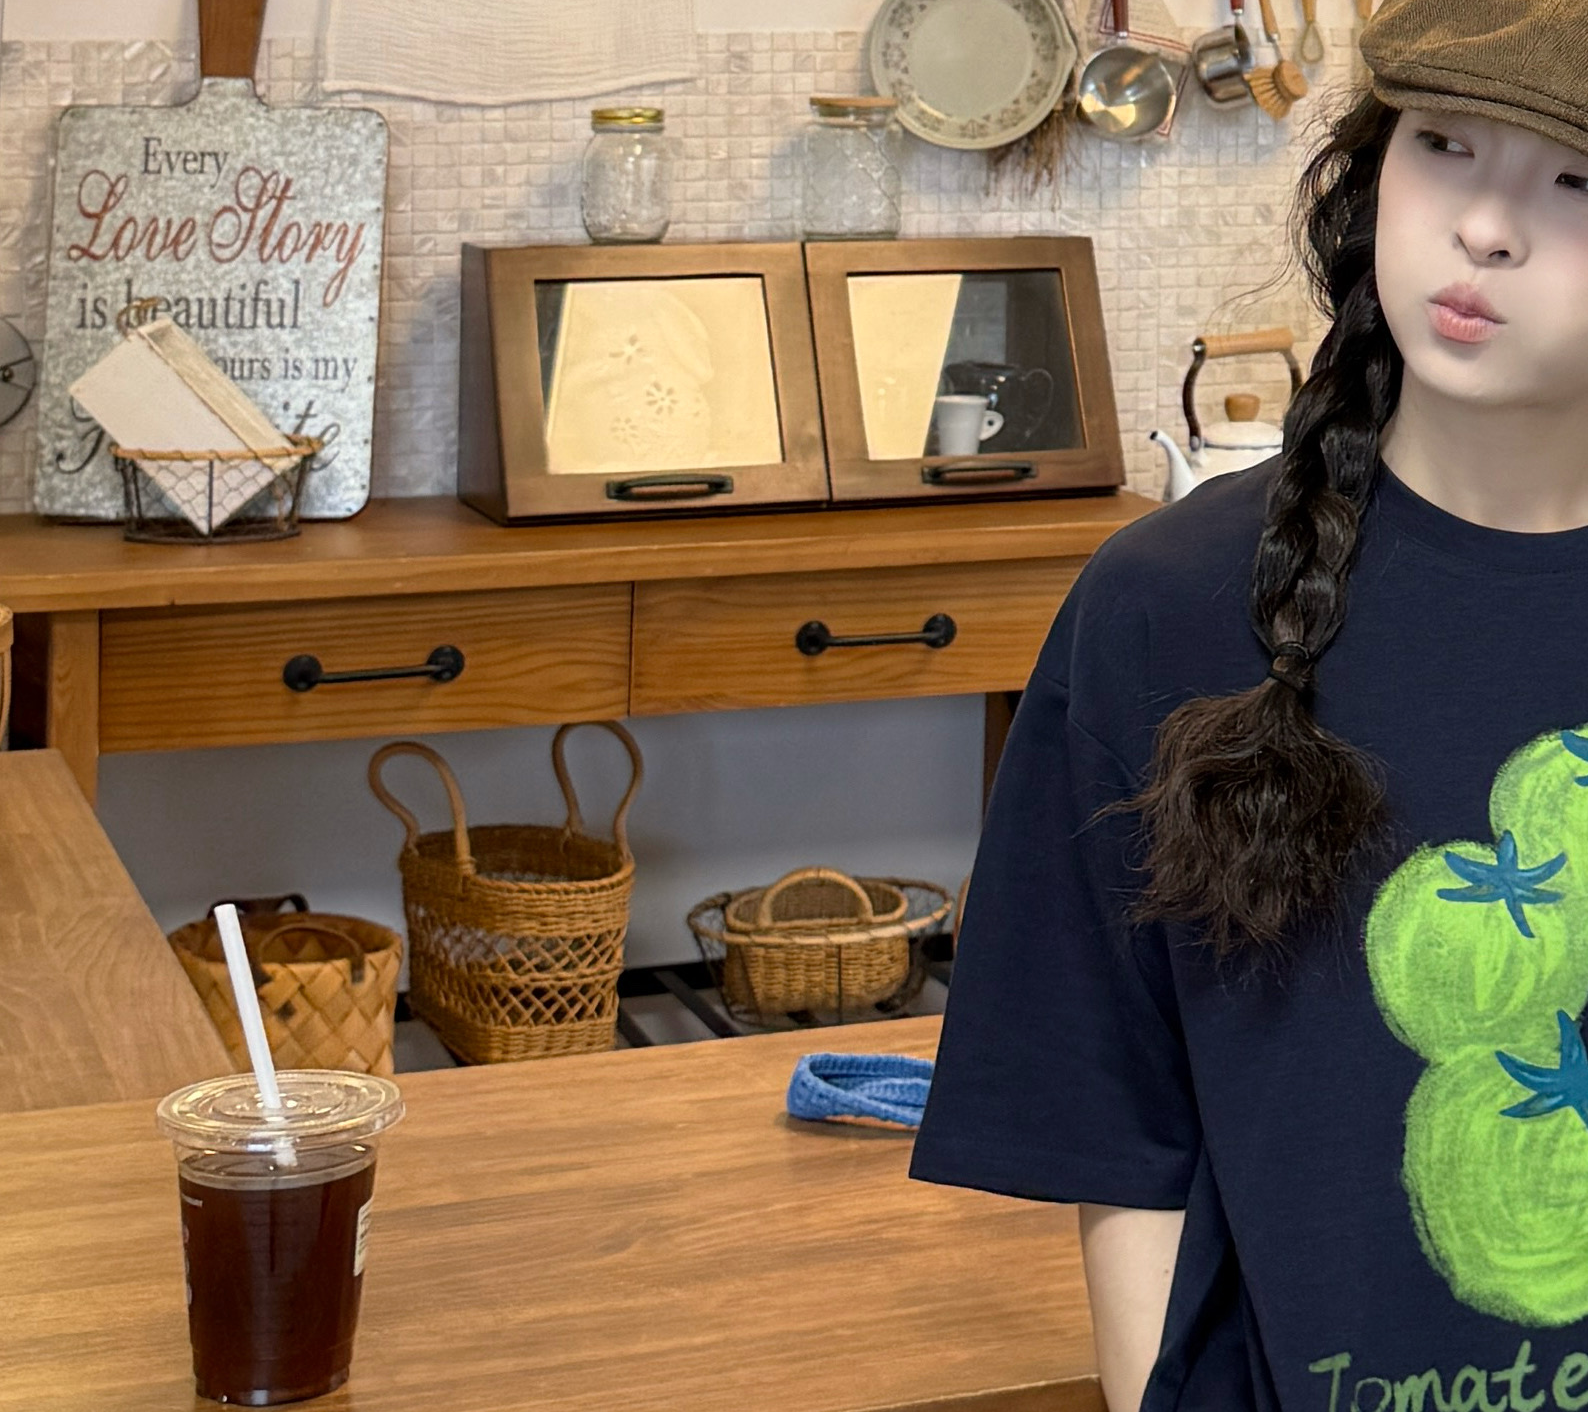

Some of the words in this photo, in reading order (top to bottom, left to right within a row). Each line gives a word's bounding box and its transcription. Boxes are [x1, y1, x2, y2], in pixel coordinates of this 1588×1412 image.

[142, 136, 229, 189] Every
[68, 168, 198, 263] Love
[208, 165, 366, 308] Story
[76, 282, 107, 330] is
[214, 355, 271, 382] ours
[283, 347, 303, 381] is
[313, 355, 358, 394] my
